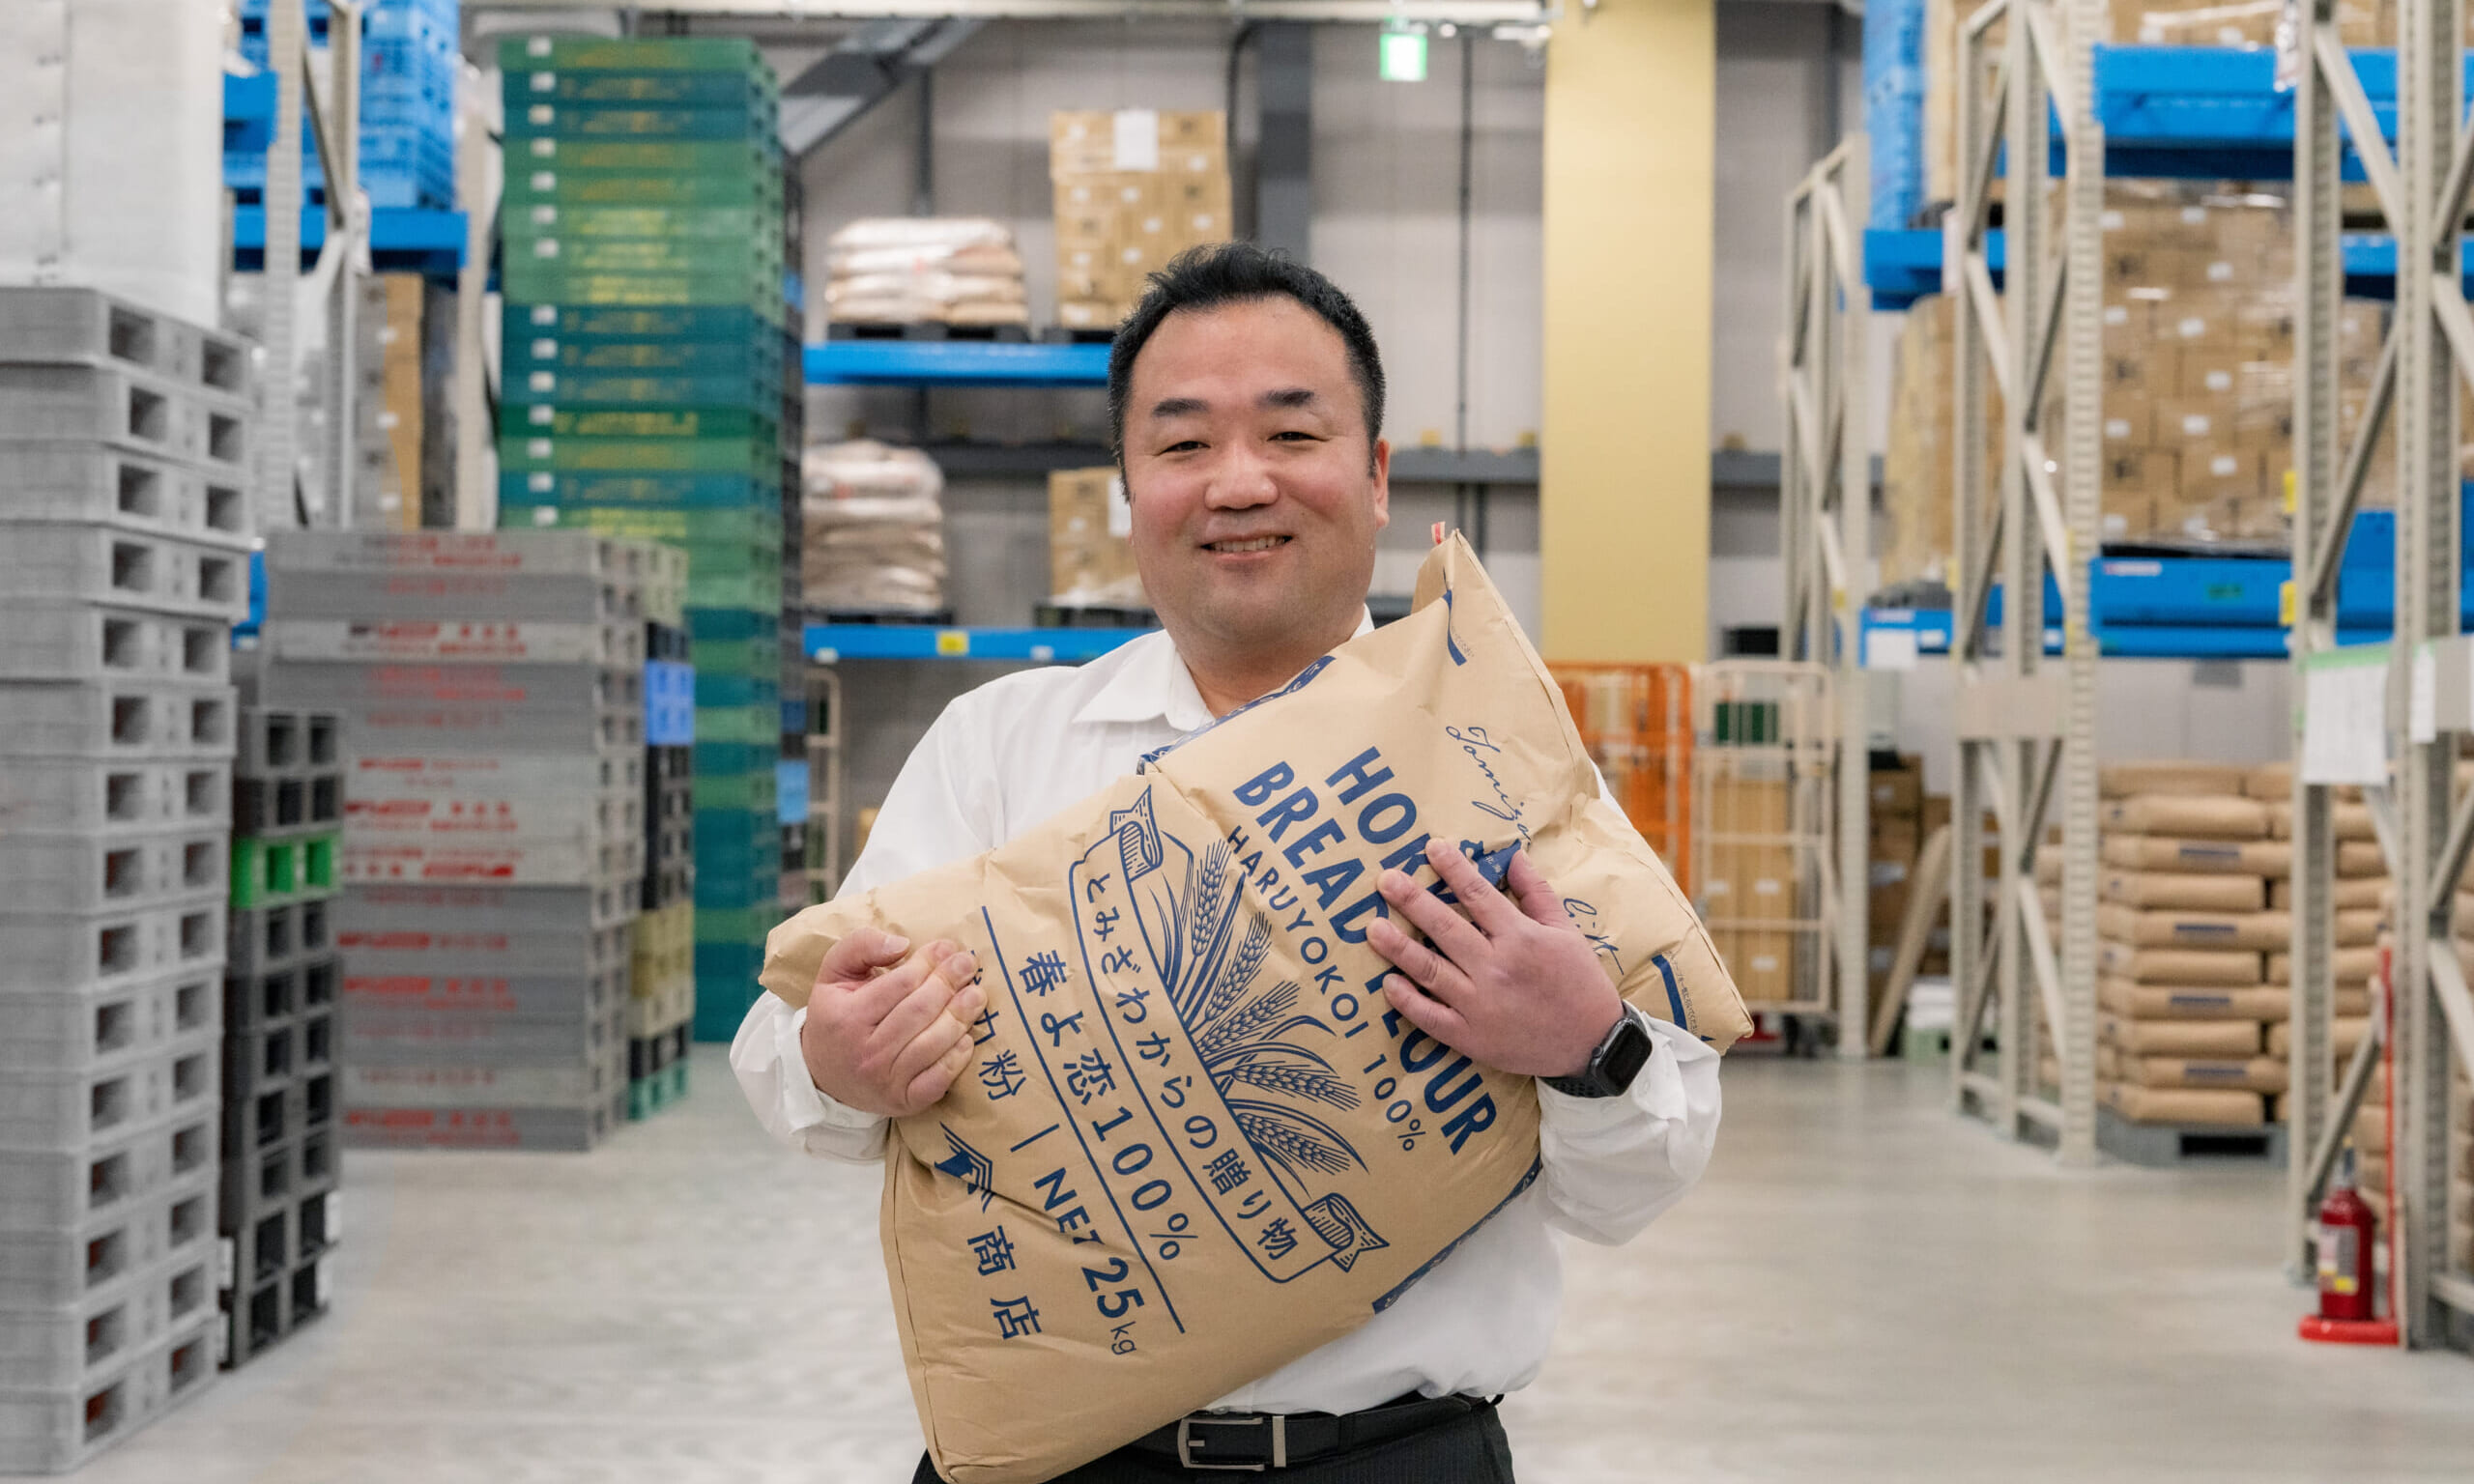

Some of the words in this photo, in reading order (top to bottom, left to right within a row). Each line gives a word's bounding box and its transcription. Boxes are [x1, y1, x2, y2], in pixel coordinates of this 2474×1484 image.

[1232, 760, 1390, 945] BREAD
[1086, 872, 1298, 1260] とみざわからの贈り物
[1227, 826, 1369, 1039] HARUYOKOI
[1364, 1054, 1426, 1151] 100%
[967, 1225, 1042, 1340] 商店
